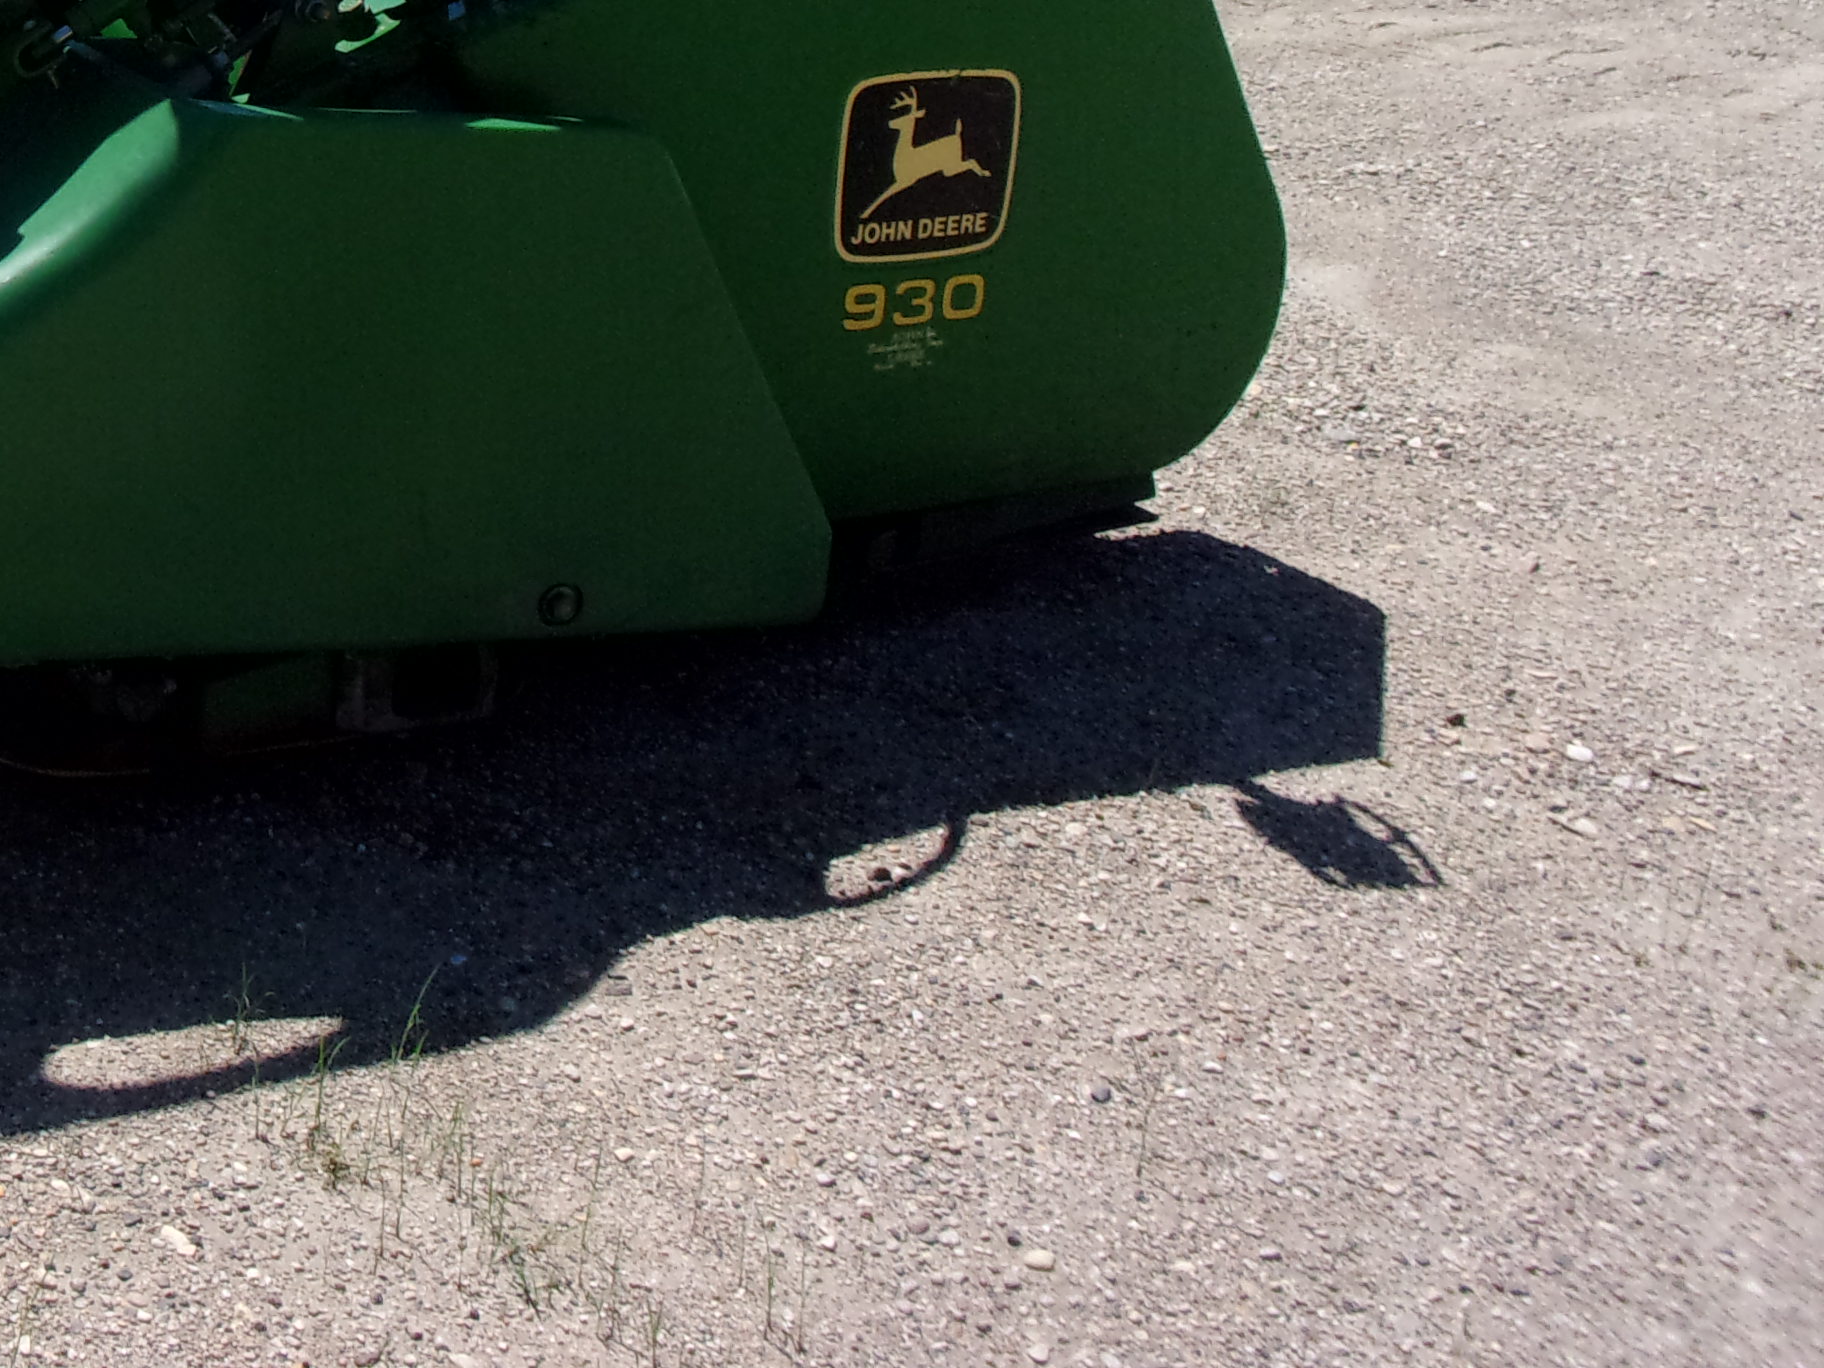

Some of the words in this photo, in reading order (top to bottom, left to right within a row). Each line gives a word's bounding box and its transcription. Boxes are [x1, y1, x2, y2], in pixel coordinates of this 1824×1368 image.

[850, 219, 913, 245] JOHN
[917, 212, 990, 240] DEERE
[842, 274, 985, 331] 930
